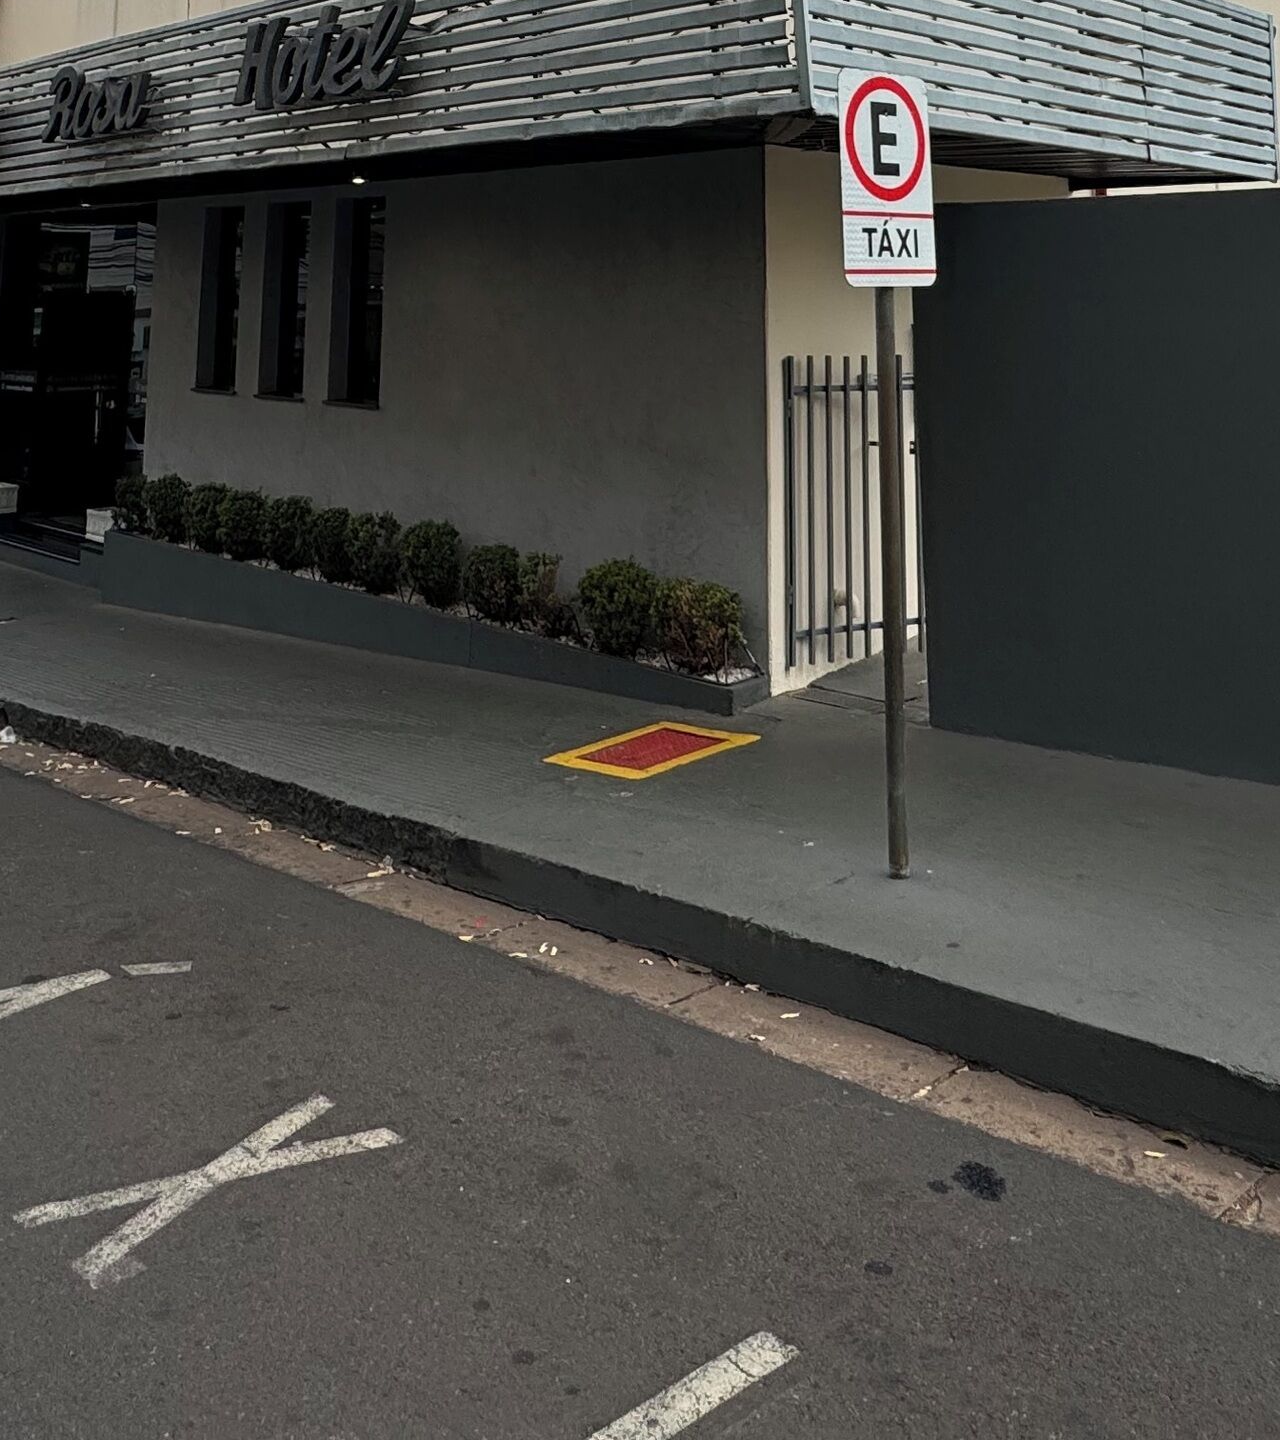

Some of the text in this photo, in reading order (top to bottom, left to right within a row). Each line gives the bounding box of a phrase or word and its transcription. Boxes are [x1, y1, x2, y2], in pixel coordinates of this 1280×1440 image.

[41, 65, 152, 143] Rosa
[870, 101, 900, 177] E
[862, 219, 920, 258] TÁXI
